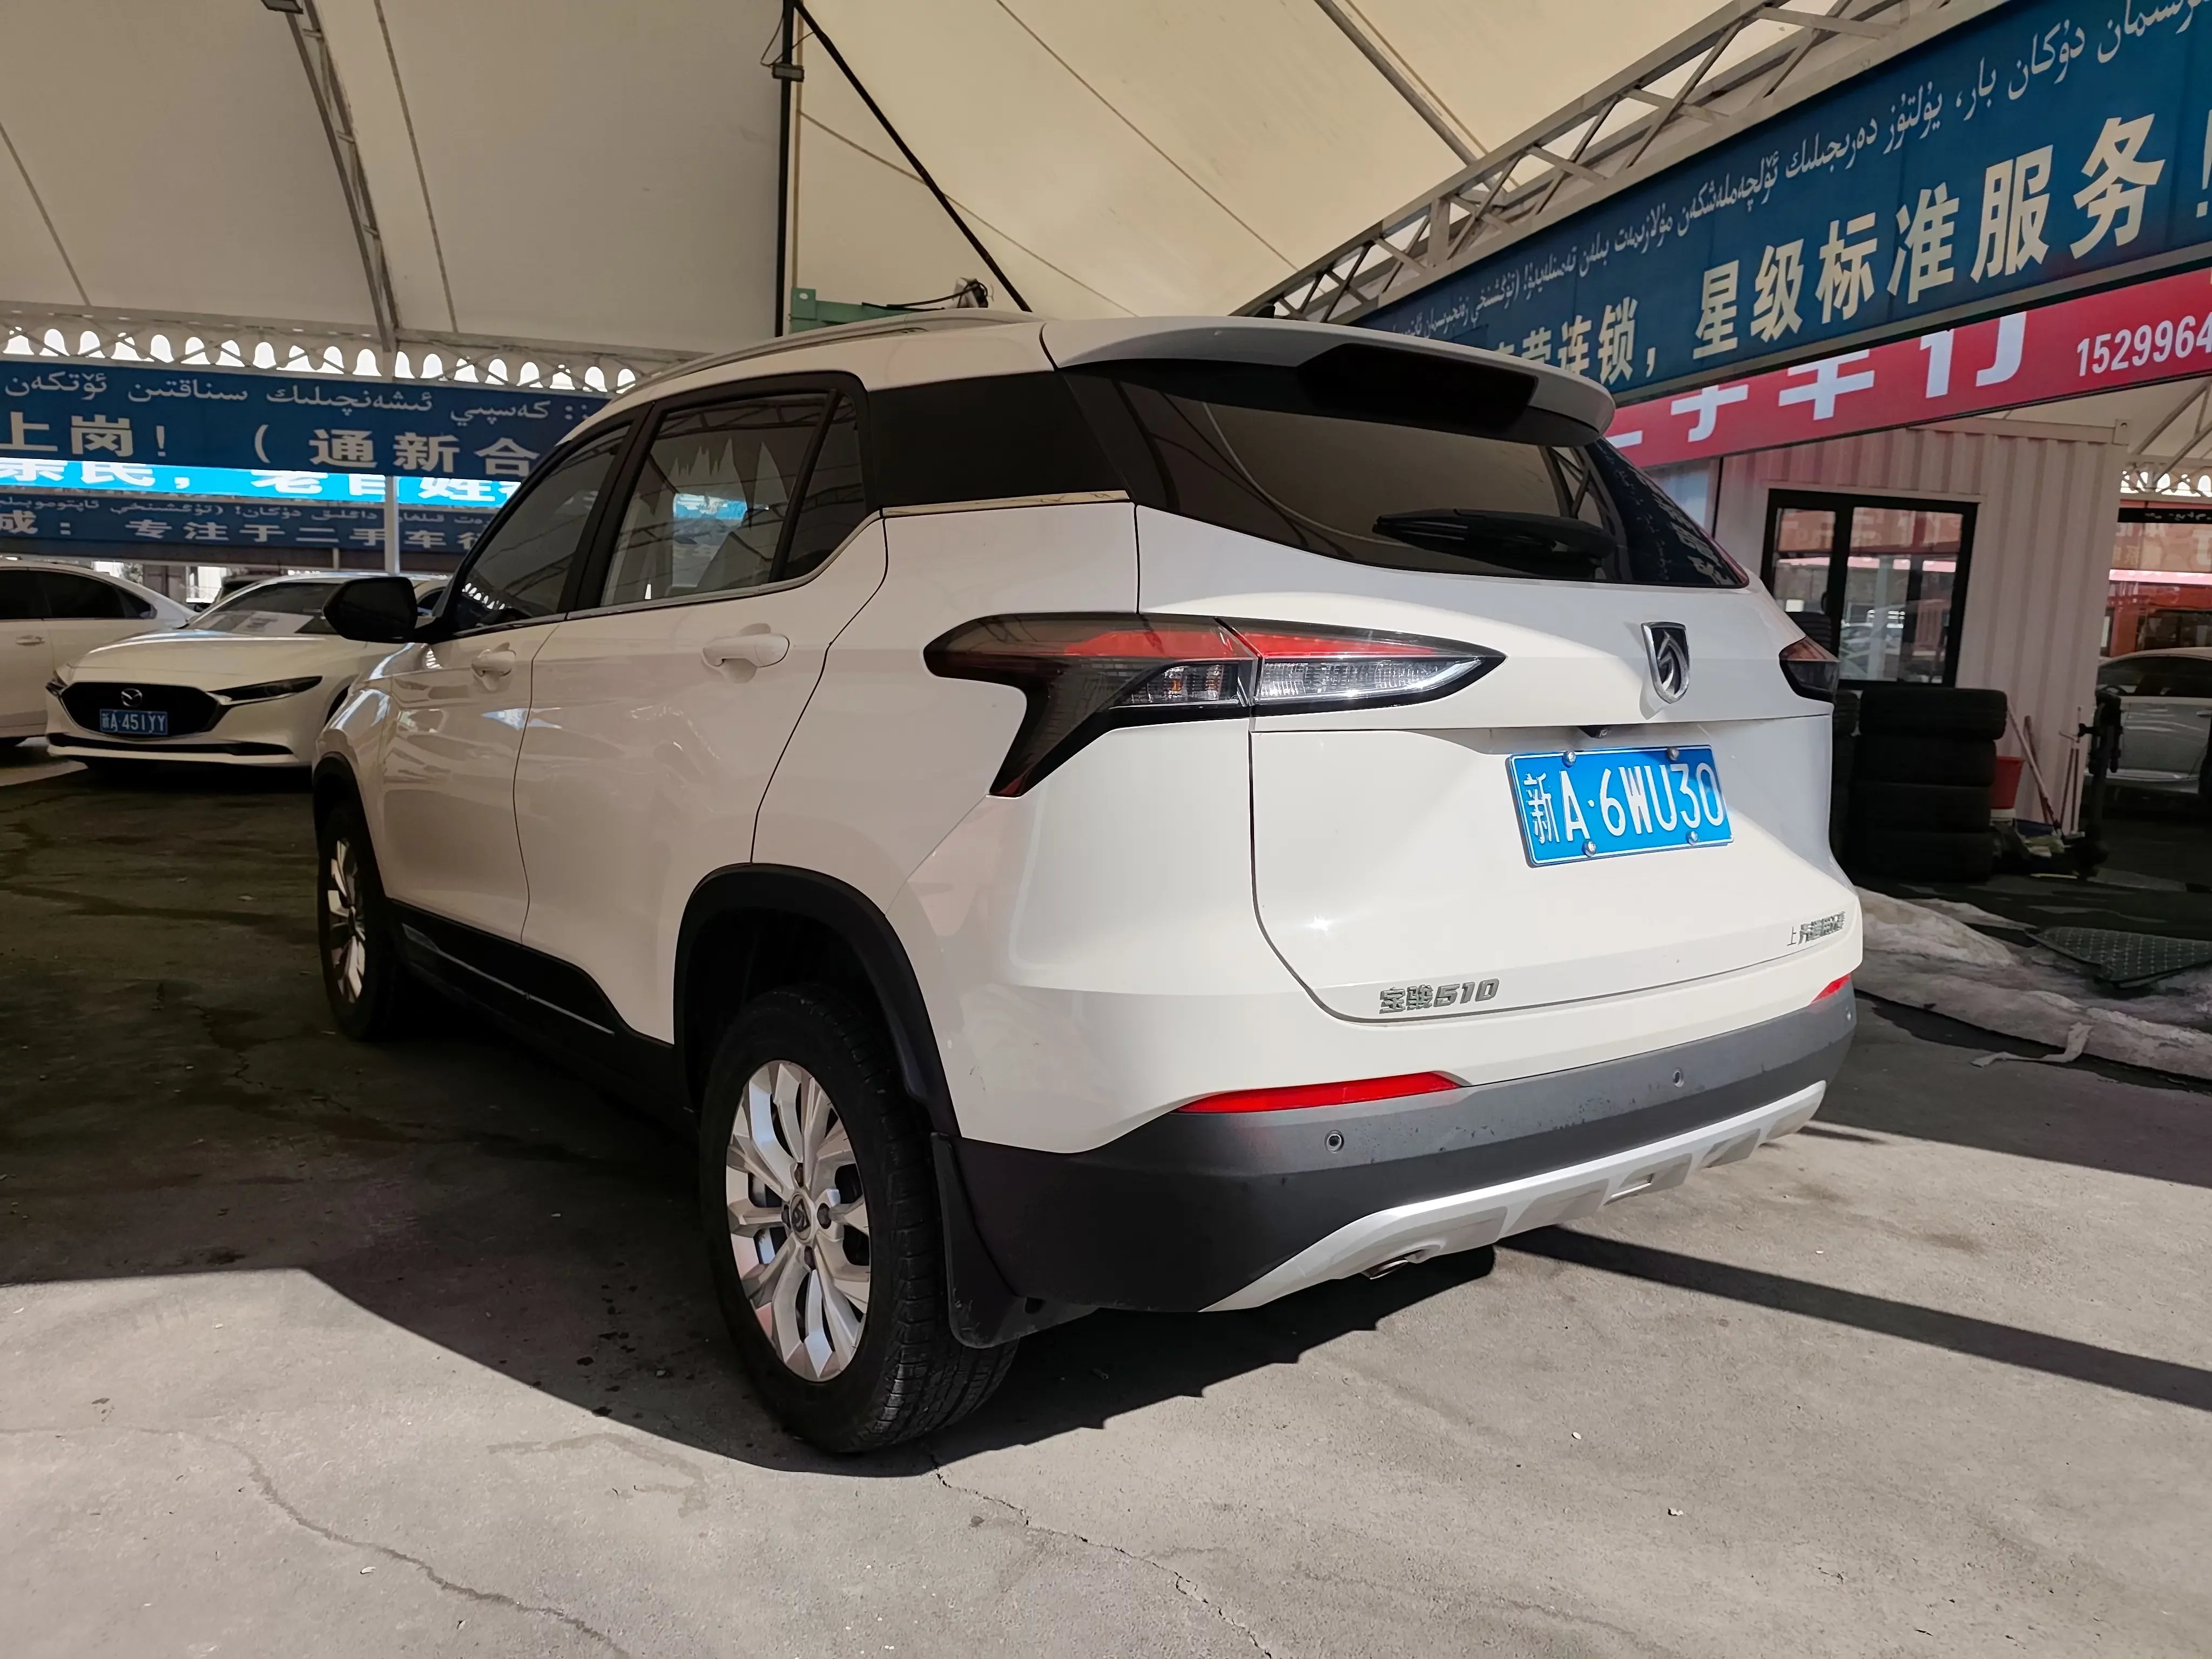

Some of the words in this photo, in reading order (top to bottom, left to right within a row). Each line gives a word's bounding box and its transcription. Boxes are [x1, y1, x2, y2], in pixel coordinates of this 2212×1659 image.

[2008, 19, 2085, 100] دۇكان
[1883, 81, 1943, 154] يۇلتۇز
[2077, 312, 2212, 376] 1529964
[4, 371, 107, 400] ئۆتكەن
[1379, 978, 1500, 1014] 宝骏510
